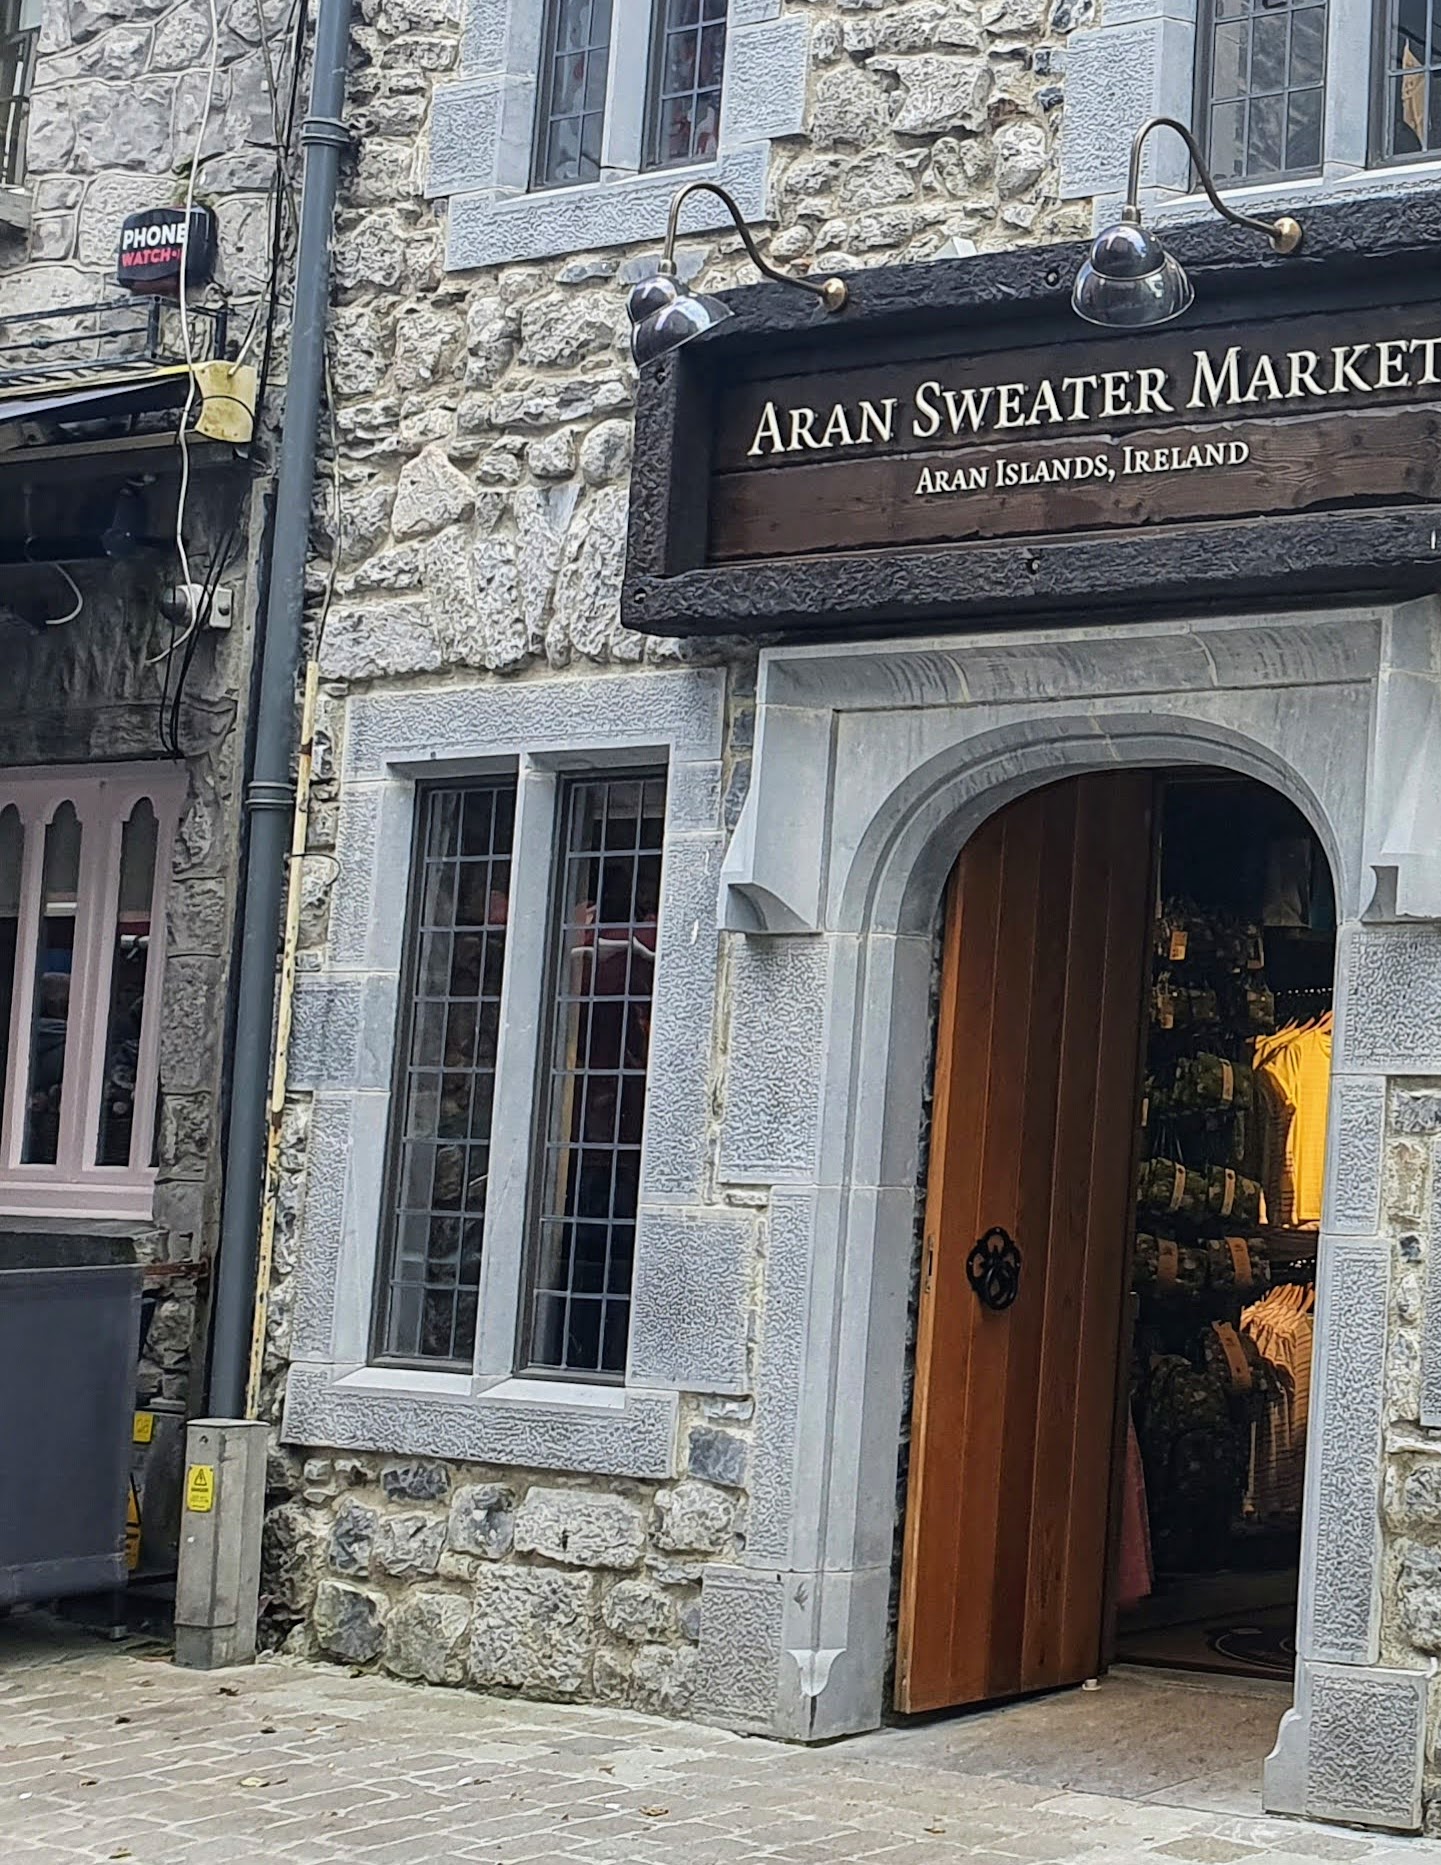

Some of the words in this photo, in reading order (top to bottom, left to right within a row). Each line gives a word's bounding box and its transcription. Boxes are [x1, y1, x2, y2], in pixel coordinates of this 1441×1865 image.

[122, 222, 188, 250] PHONE
[746, 397, 898, 456] ARAN
[912, 366, 1175, 439] SWEATER
[914, 466, 989, 495] ARAN
[995, 453, 1116, 488] ISLANDS,
[1122, 440, 1250, 475] IRELAND
